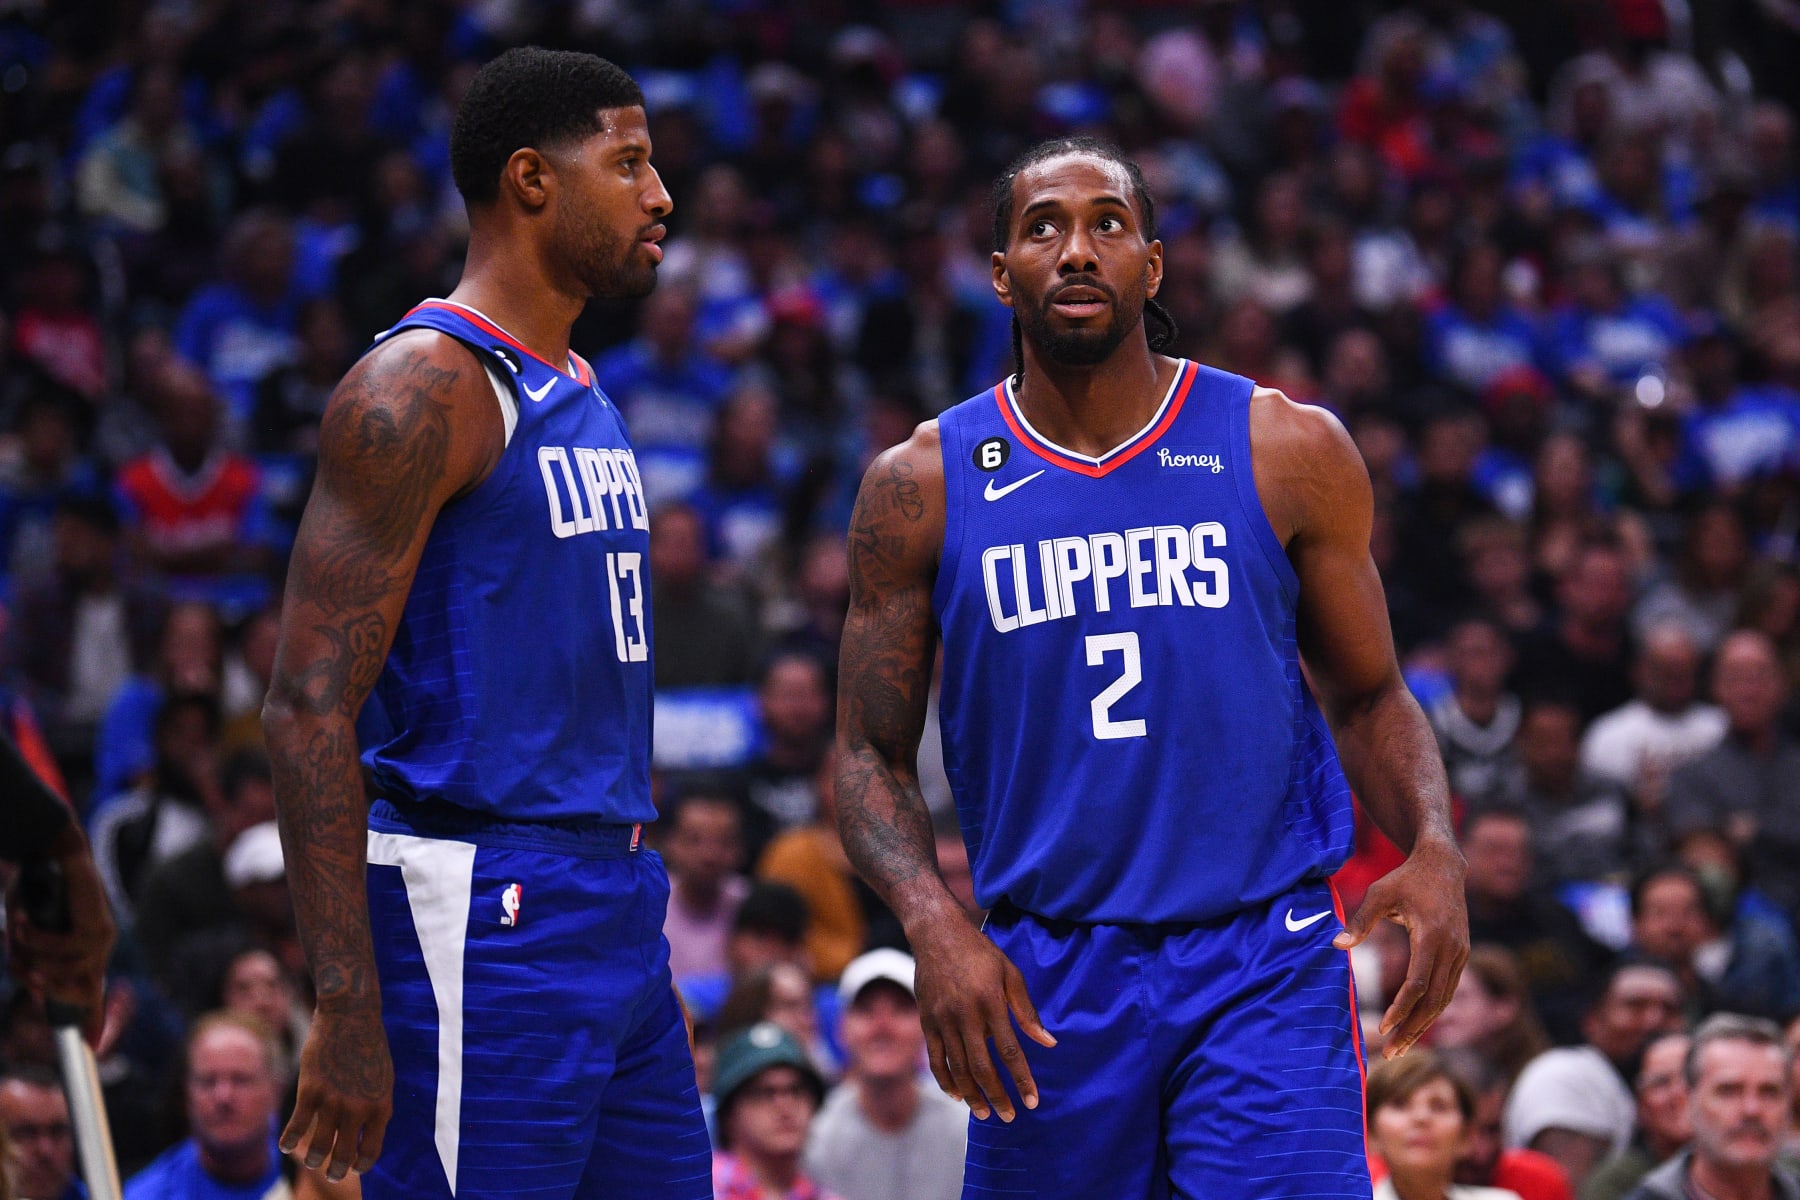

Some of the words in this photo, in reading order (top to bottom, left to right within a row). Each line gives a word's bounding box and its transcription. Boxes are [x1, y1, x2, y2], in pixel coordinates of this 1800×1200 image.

[981, 441, 1002, 469] 6
[1156, 447, 1225, 474] honey
[605, 552, 650, 663] 13
[981, 521, 1230, 634] CLIPPERS
[1084, 631, 1148, 741] 2
